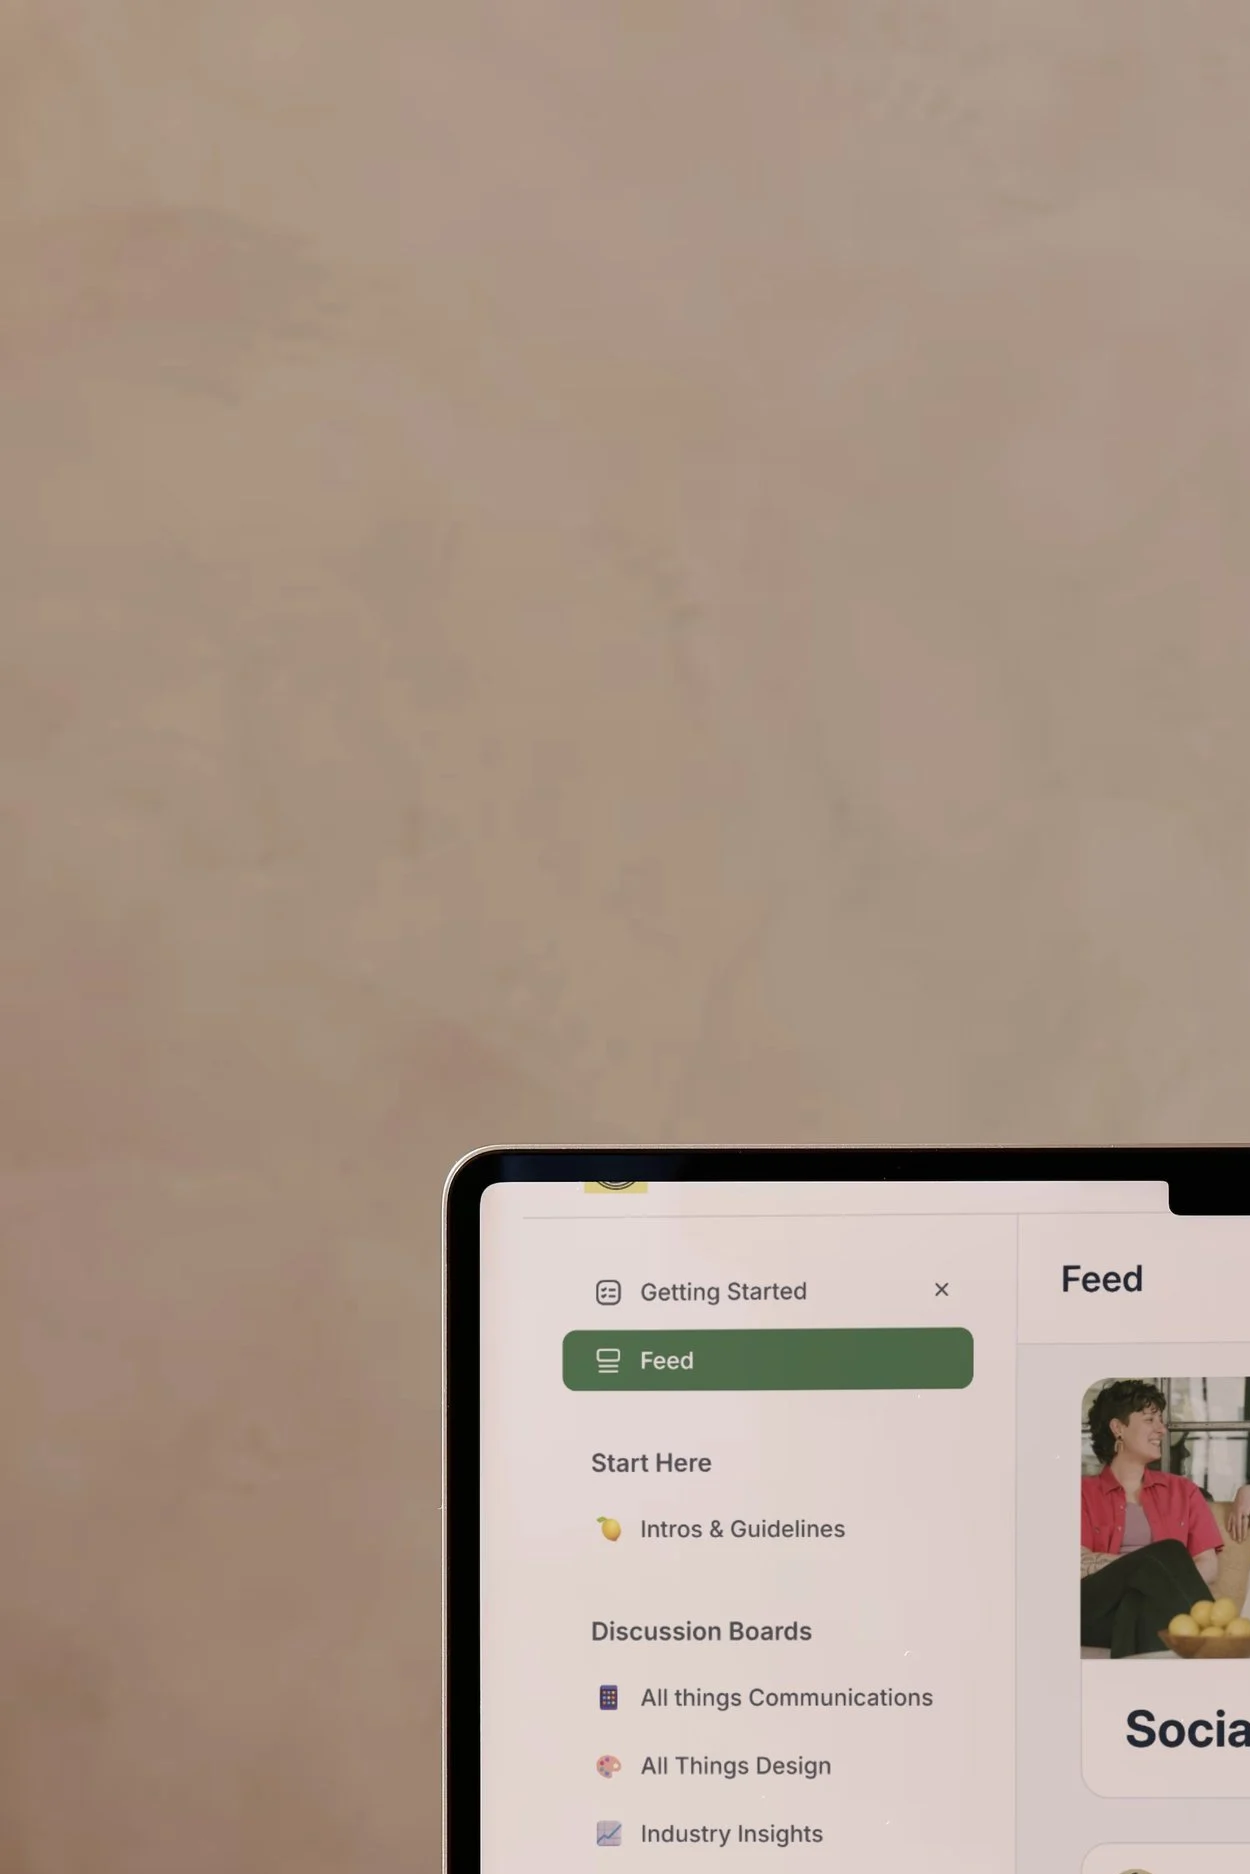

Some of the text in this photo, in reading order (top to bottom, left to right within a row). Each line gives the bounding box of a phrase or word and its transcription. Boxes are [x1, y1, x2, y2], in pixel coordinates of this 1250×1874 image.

[1062, 1264, 1143, 1293] Feed
[640, 1281, 807, 1305] Getting Started
[641, 1350, 694, 1371] Feed
[591, 1452, 712, 1473] Start Here
[641, 1518, 846, 1539] Intros & Guidelines
[591, 1620, 813, 1642] Discussion Boards
[640, 1687, 934, 1712] All things Communications
[640, 1755, 832, 1780] All Things Design
[641, 1823, 824, 1848] Industry Insights
